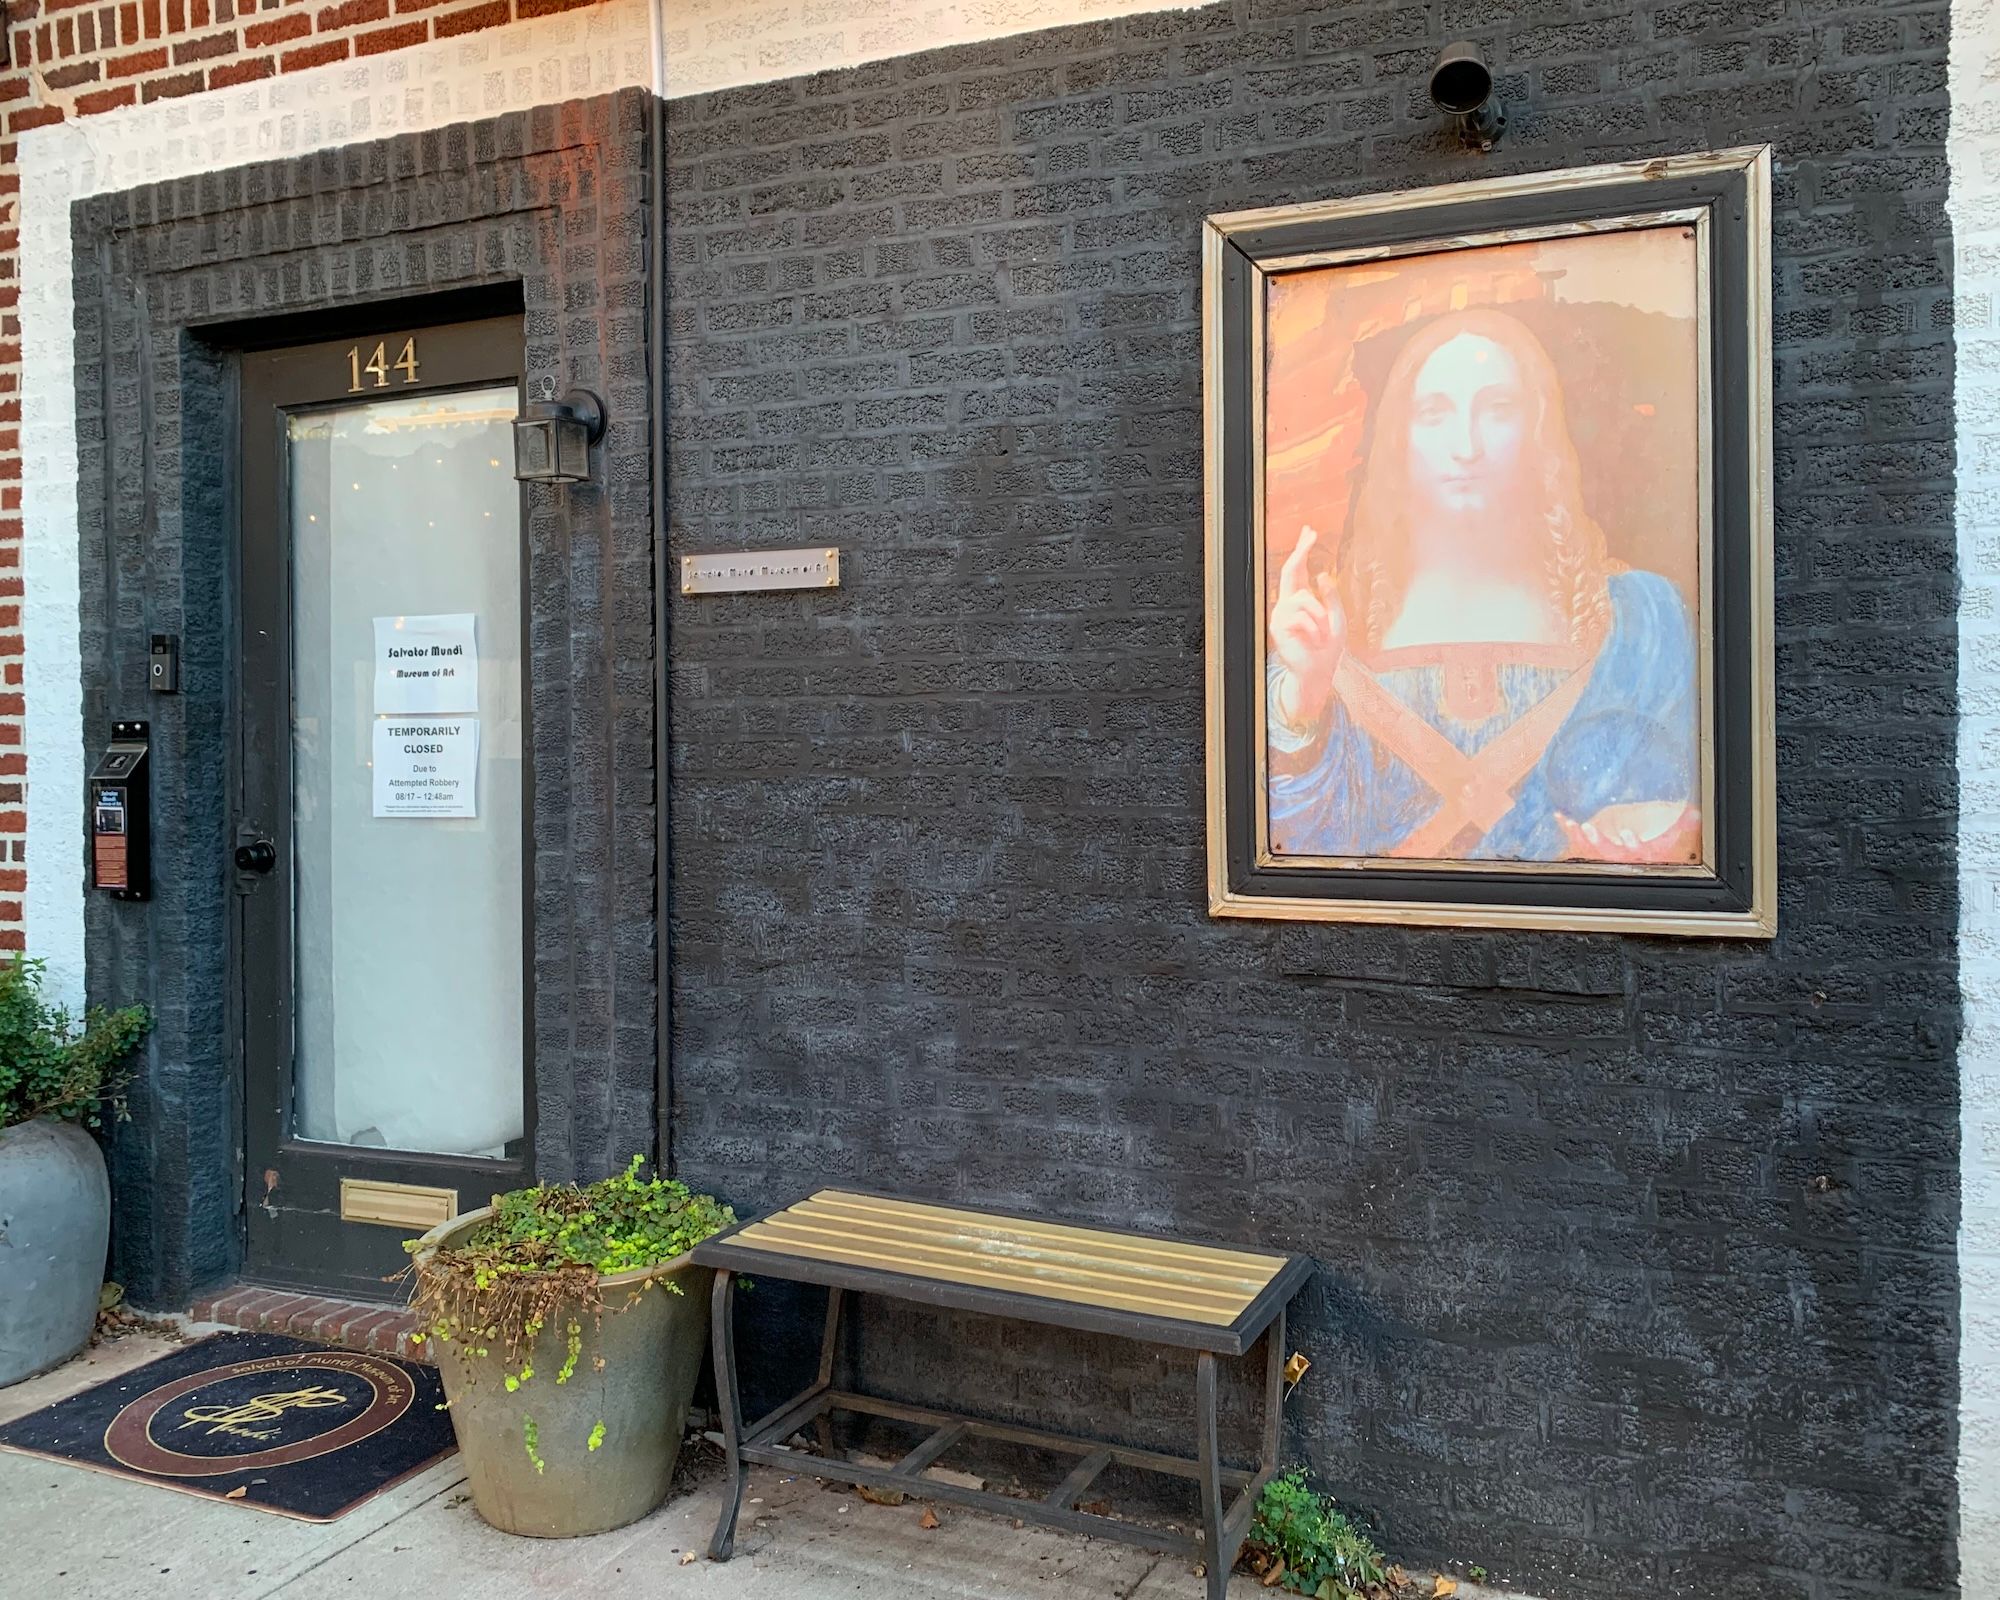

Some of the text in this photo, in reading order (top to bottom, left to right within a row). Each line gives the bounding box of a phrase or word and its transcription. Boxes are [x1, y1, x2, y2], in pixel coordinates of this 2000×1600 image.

[347, 337, 421, 393] 144
[388, 644, 463, 658] Salvator Mundi
[396, 668, 455, 678] Museum of Art
[387, 726, 461, 736] TEMPORARILY
[404, 744, 443, 754] CLOSED
[413, 764, 437, 773] Due to
[389, 778, 459, 788] Attempted Robbery
[395, 792, 415, 801] 08/17
[231, 1358, 304, 1375] Salvator
[307, 1357, 357, 1369] Mundi
[355, 1361, 396, 1388] Museum
